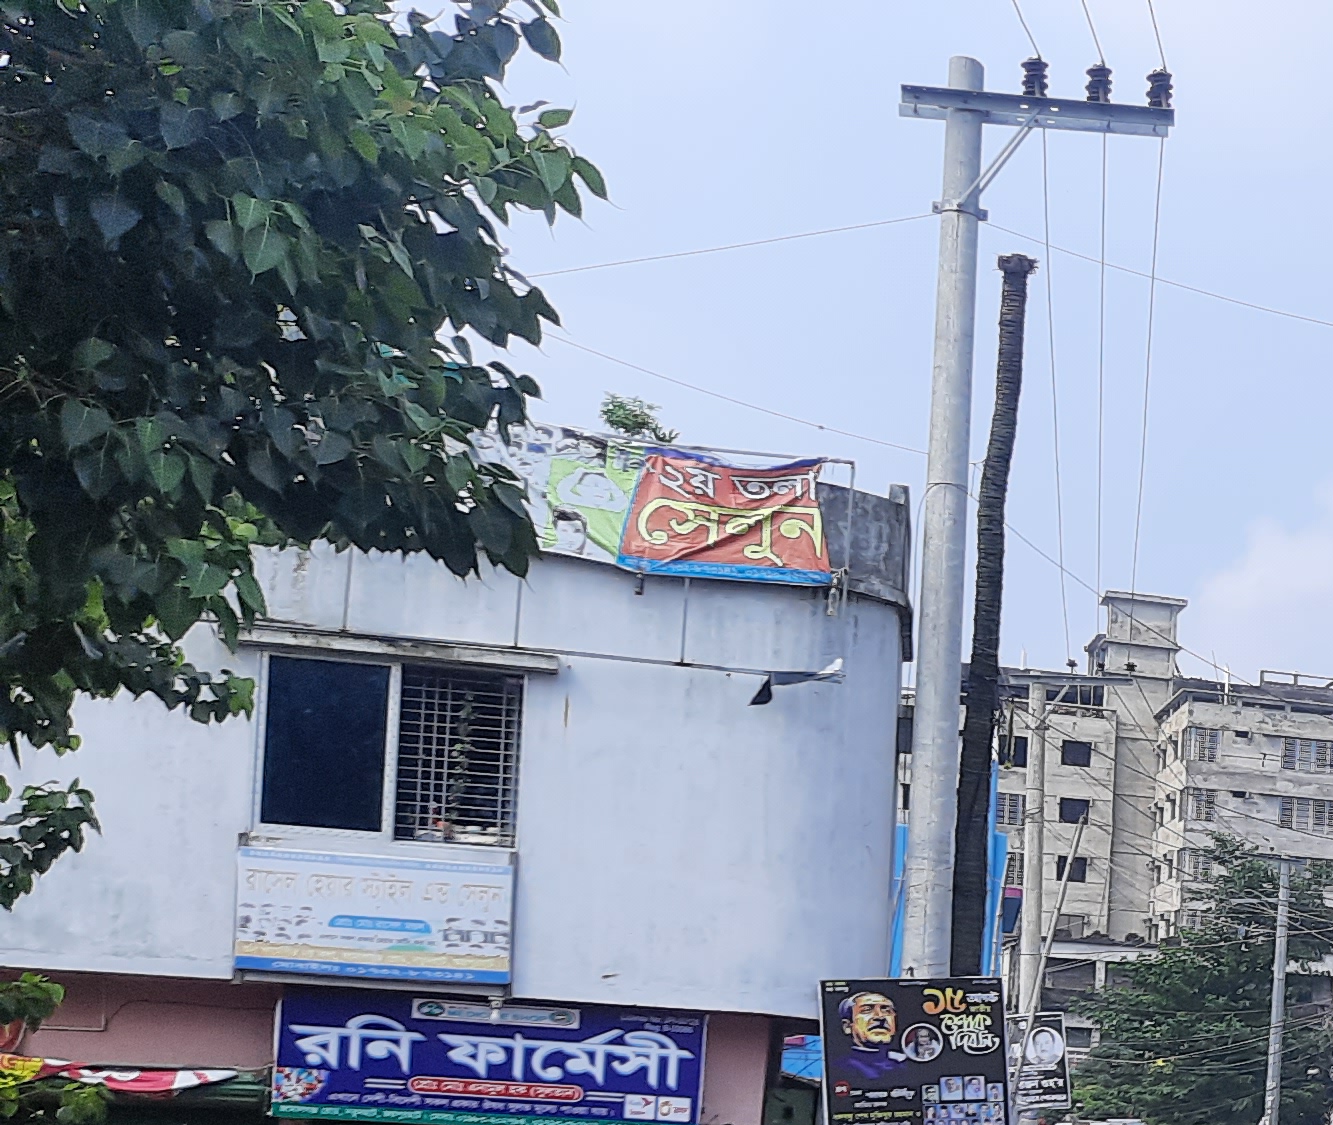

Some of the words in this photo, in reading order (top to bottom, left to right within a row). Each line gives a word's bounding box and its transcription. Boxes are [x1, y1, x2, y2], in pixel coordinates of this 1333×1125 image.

[658, 466, 721, 499] ২য়
[730, 470, 819, 502] তলা
[637, 497, 824, 567] সেলুন
[922, 987, 968, 1015] ১৫
[288, 1014, 428, 1076] রনি
[436, 1027, 696, 1092] ফার্মেসী
